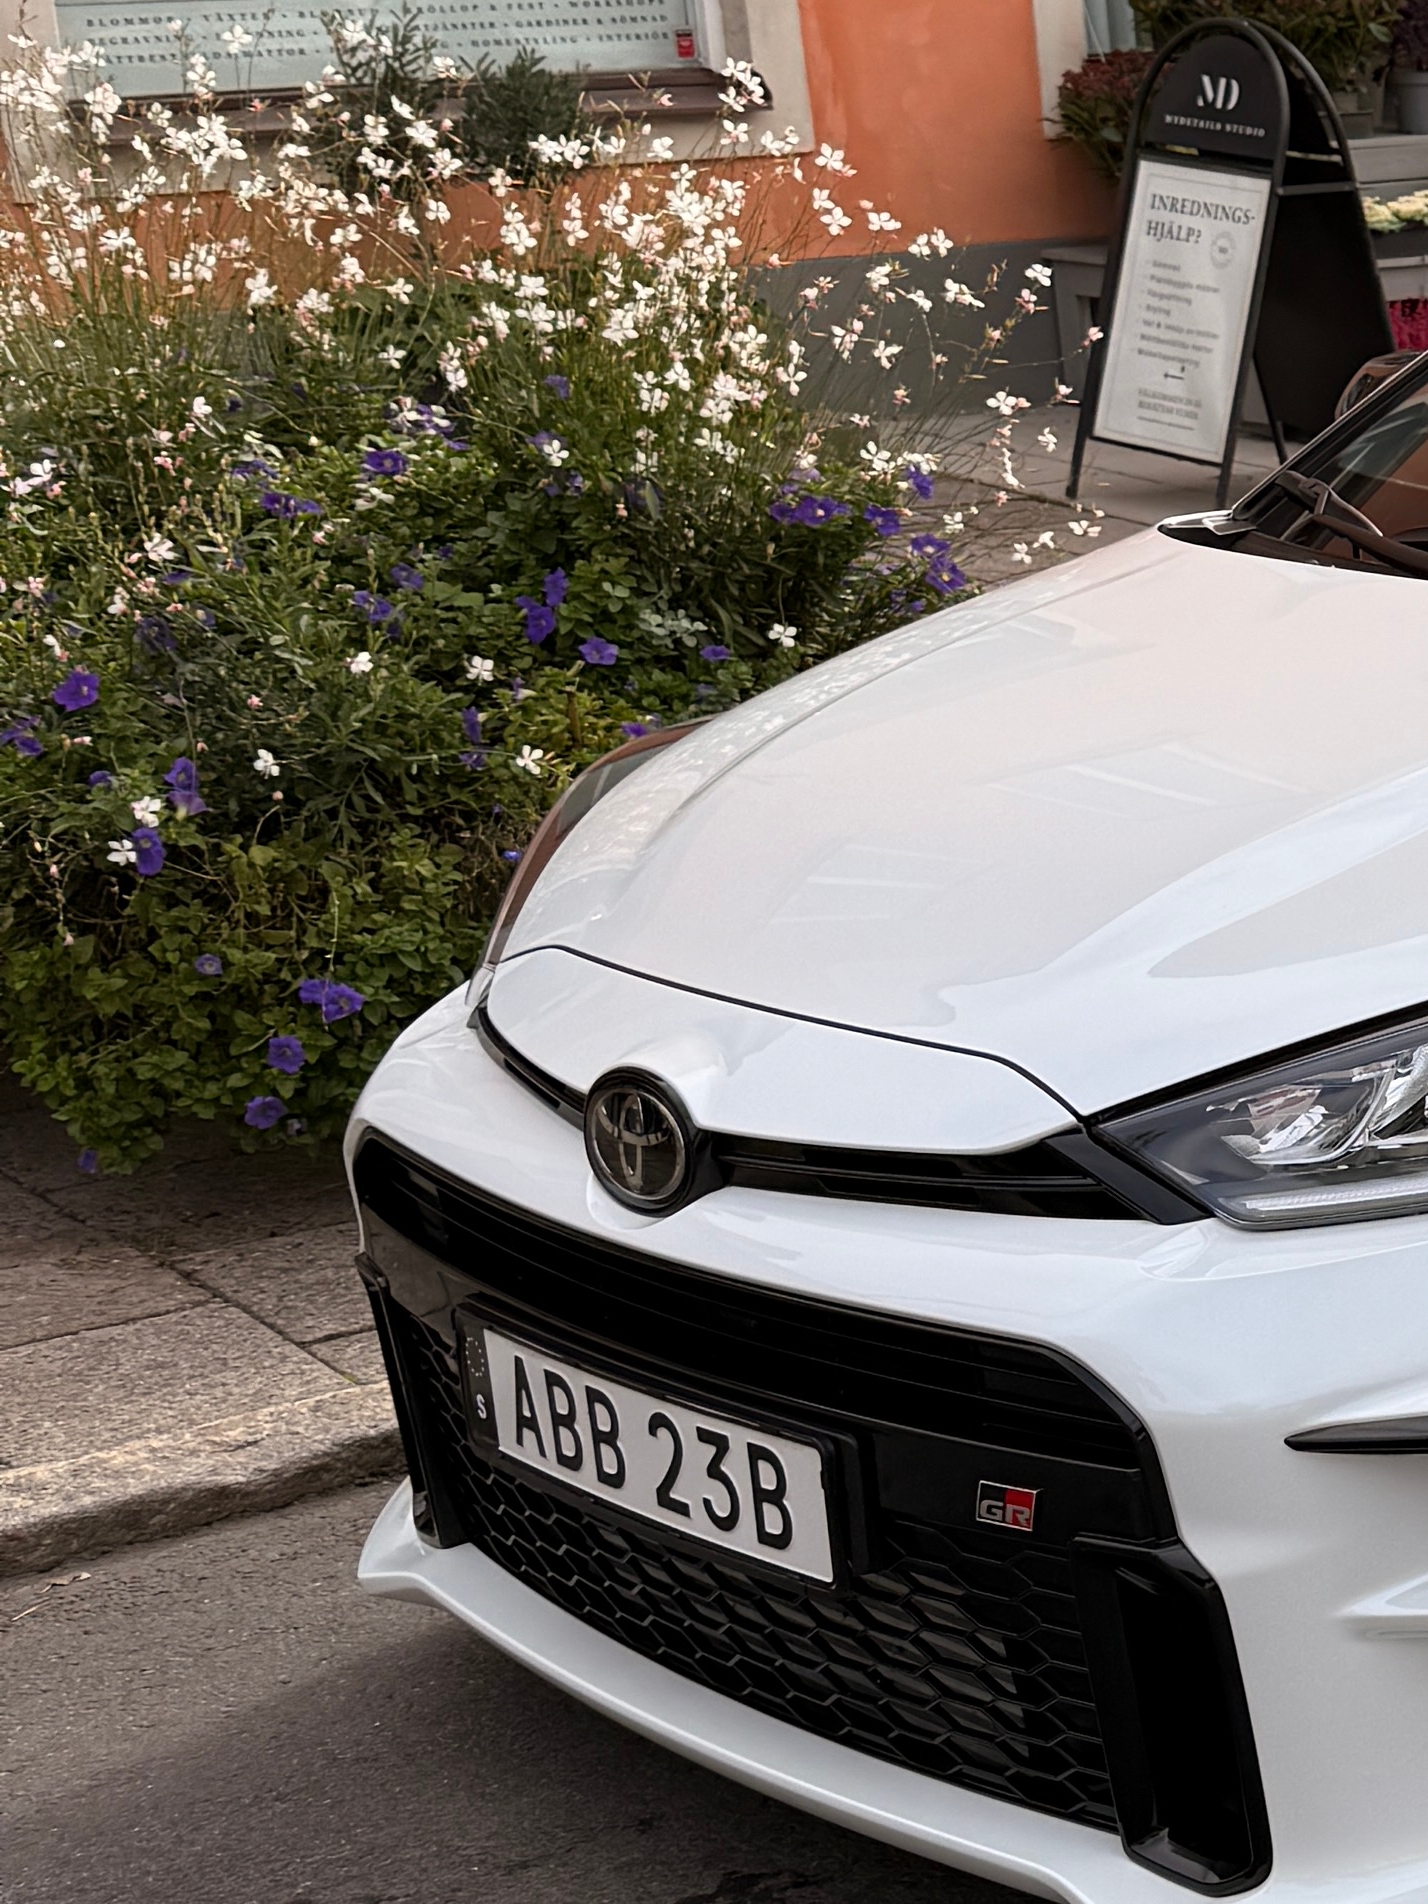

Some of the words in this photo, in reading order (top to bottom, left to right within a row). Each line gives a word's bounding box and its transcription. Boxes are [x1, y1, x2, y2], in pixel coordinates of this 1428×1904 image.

[507, 2, 544, 10] FEST
[515, 18, 589, 28] GARDINER
[471, 36, 577, 47] HOMESTYLING
[1225, 123, 1266, 137] STUDIO
[1150, 193, 1255, 226] INREDNINGS-
[1146, 220, 1202, 244] HJÄLP?
[476, 1394, 487, 1419] S
[514, 1354, 627, 1490] ABB
[647, 1412, 793, 1551] 23B
[979, 1499, 1031, 1528] GR
